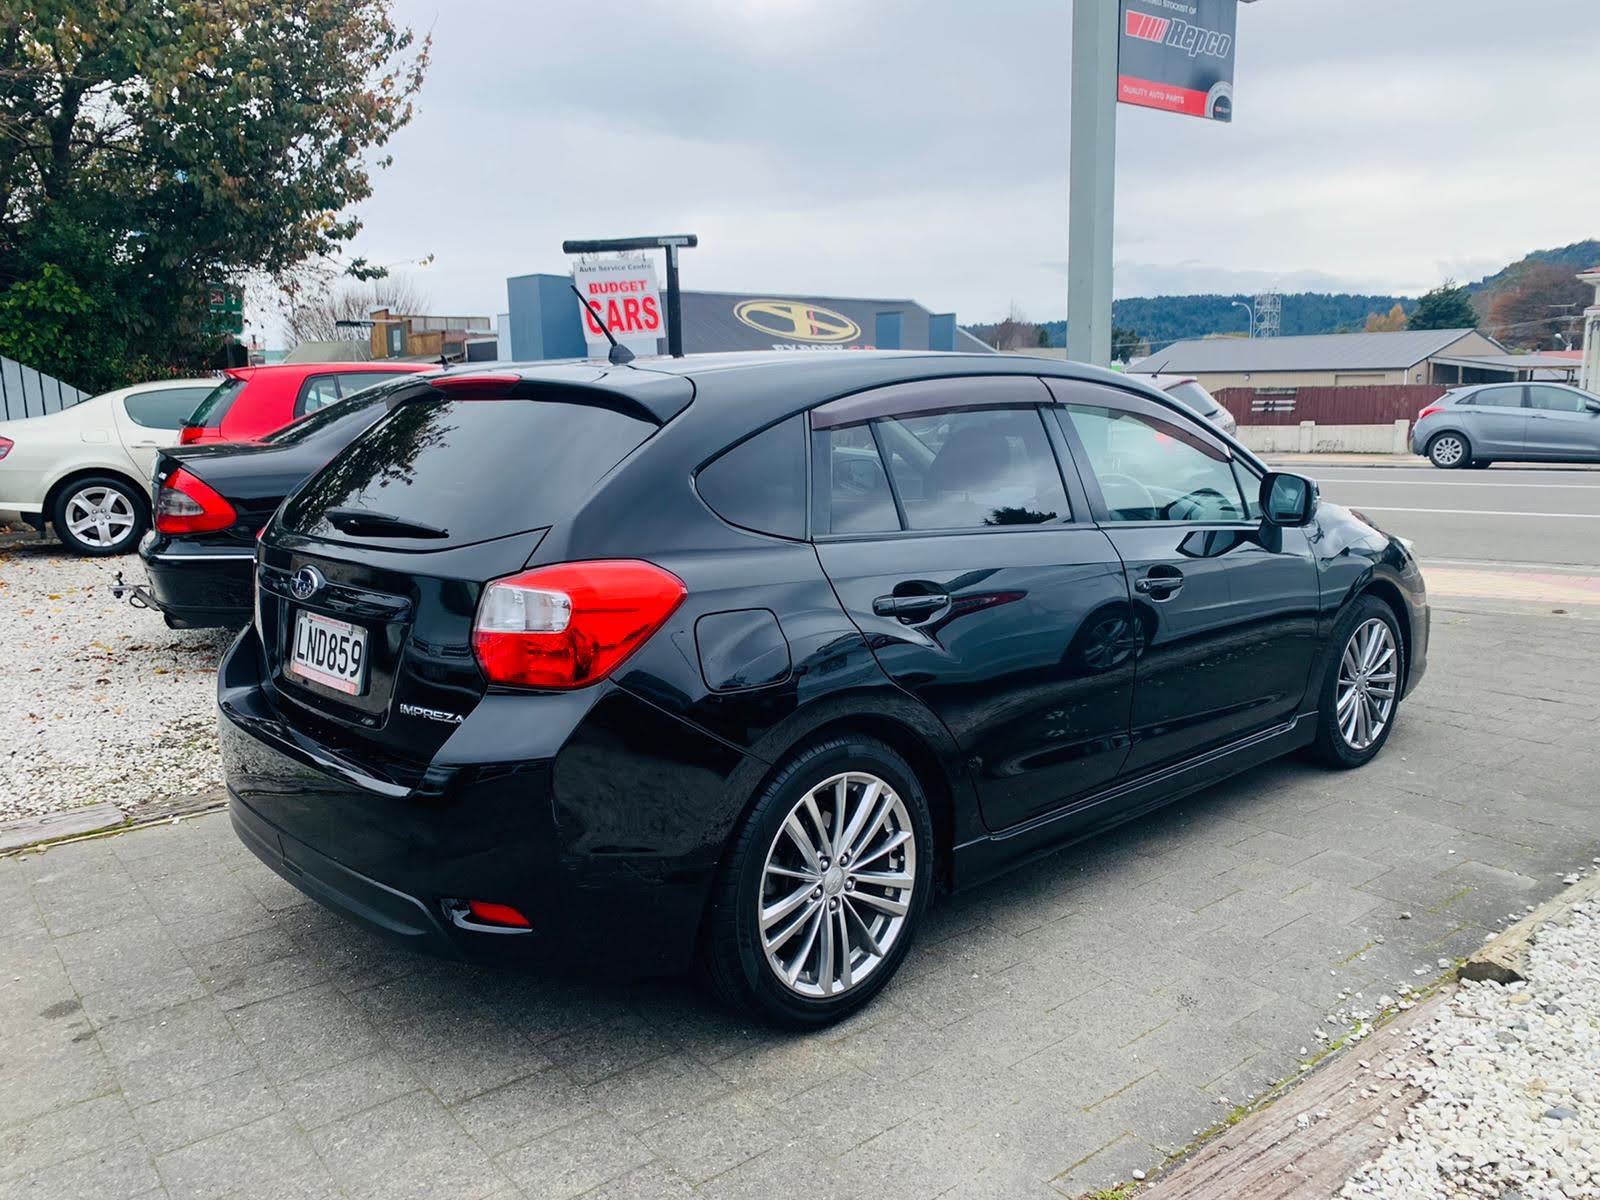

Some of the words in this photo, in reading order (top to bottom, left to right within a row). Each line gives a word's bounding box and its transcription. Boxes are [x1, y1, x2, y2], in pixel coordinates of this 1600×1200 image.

[1166, 17, 1232, 58] Repco
[1123, 84, 1148, 97] QUALITY
[1149, 90, 1165, 101] AUTO
[1166, 93, 1185, 104] PARTS
[579, 265, 597, 273] Auto
[599, 264, 626, 272] Service
[588, 280, 647, 294] BUDGET
[585, 296, 659, 335] CARS
[296, 622, 363, 678] LND859
[400, 704, 464, 724] IMPREZA
